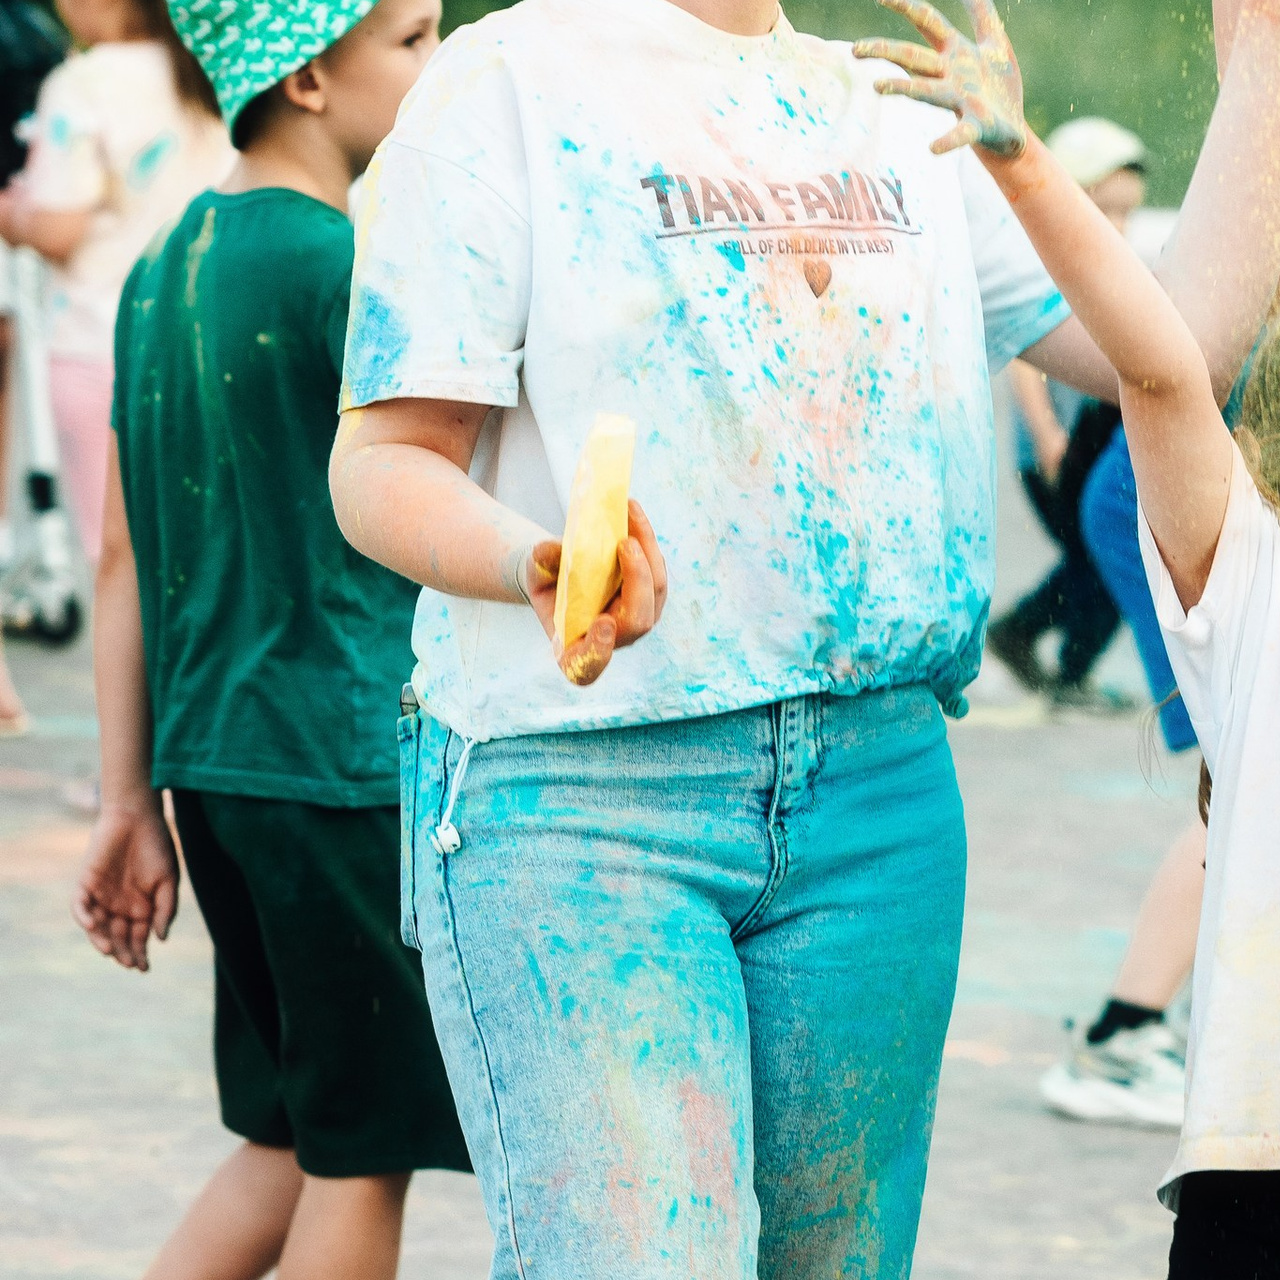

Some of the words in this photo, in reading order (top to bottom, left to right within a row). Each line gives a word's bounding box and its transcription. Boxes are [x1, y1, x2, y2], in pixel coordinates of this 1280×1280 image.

[640, 173, 765, 229] TIAN
[766, 170, 911, 227] FAMILY
[758, 238, 774, 255] OF
[777, 236, 837, 255] CHILDLIKE
